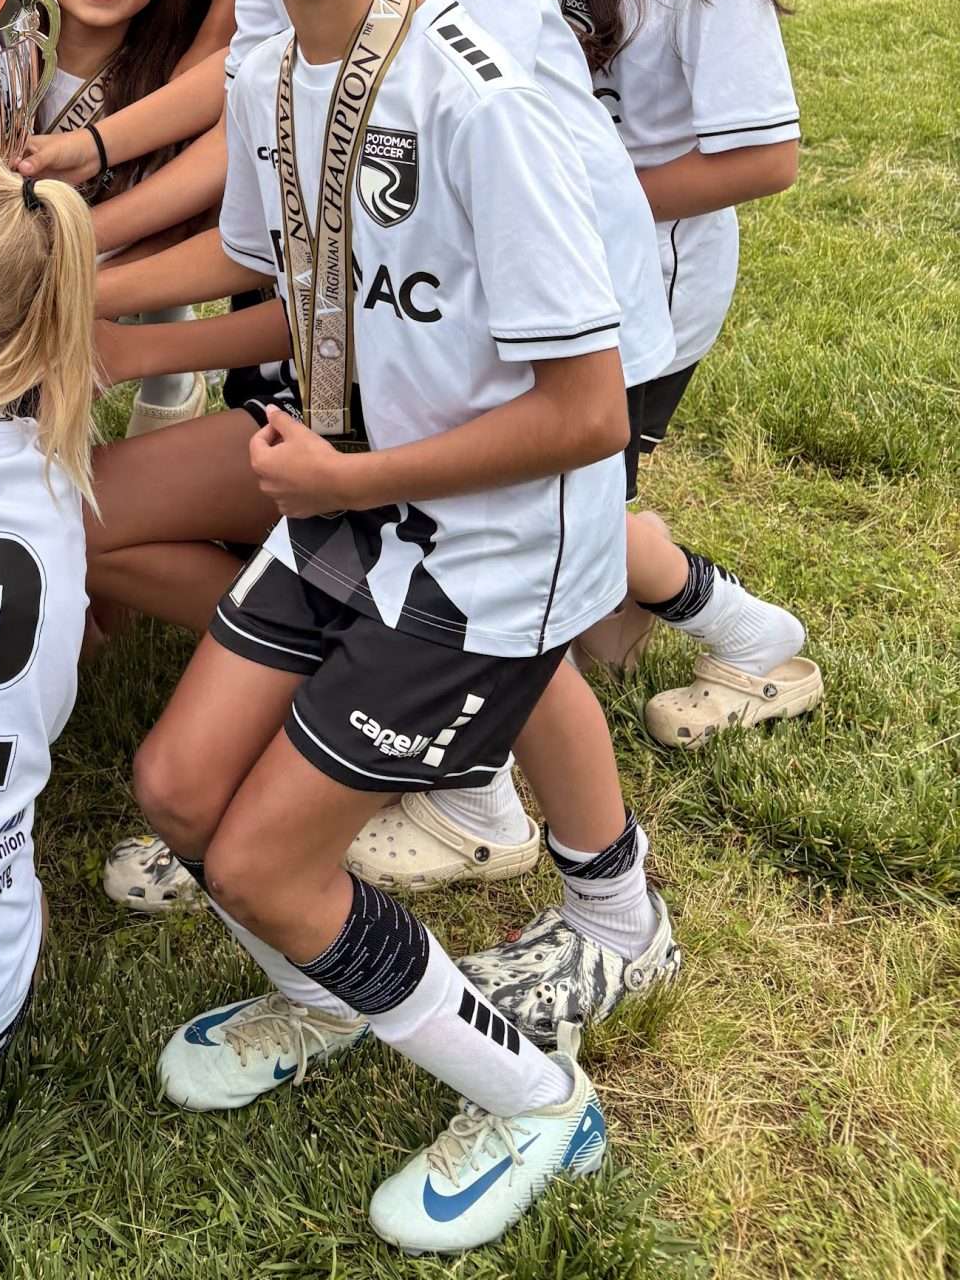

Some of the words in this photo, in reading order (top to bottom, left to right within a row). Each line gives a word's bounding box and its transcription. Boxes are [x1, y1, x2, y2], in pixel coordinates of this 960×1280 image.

[279, 54, 307, 243] CHAMPION
[323, 42, 382, 234] CHAMPION
[364, 143, 404, 159] SOCCER
[367, 133, 412, 149] POTOMAC
[317, 237, 343, 314] VIRGINIAN
